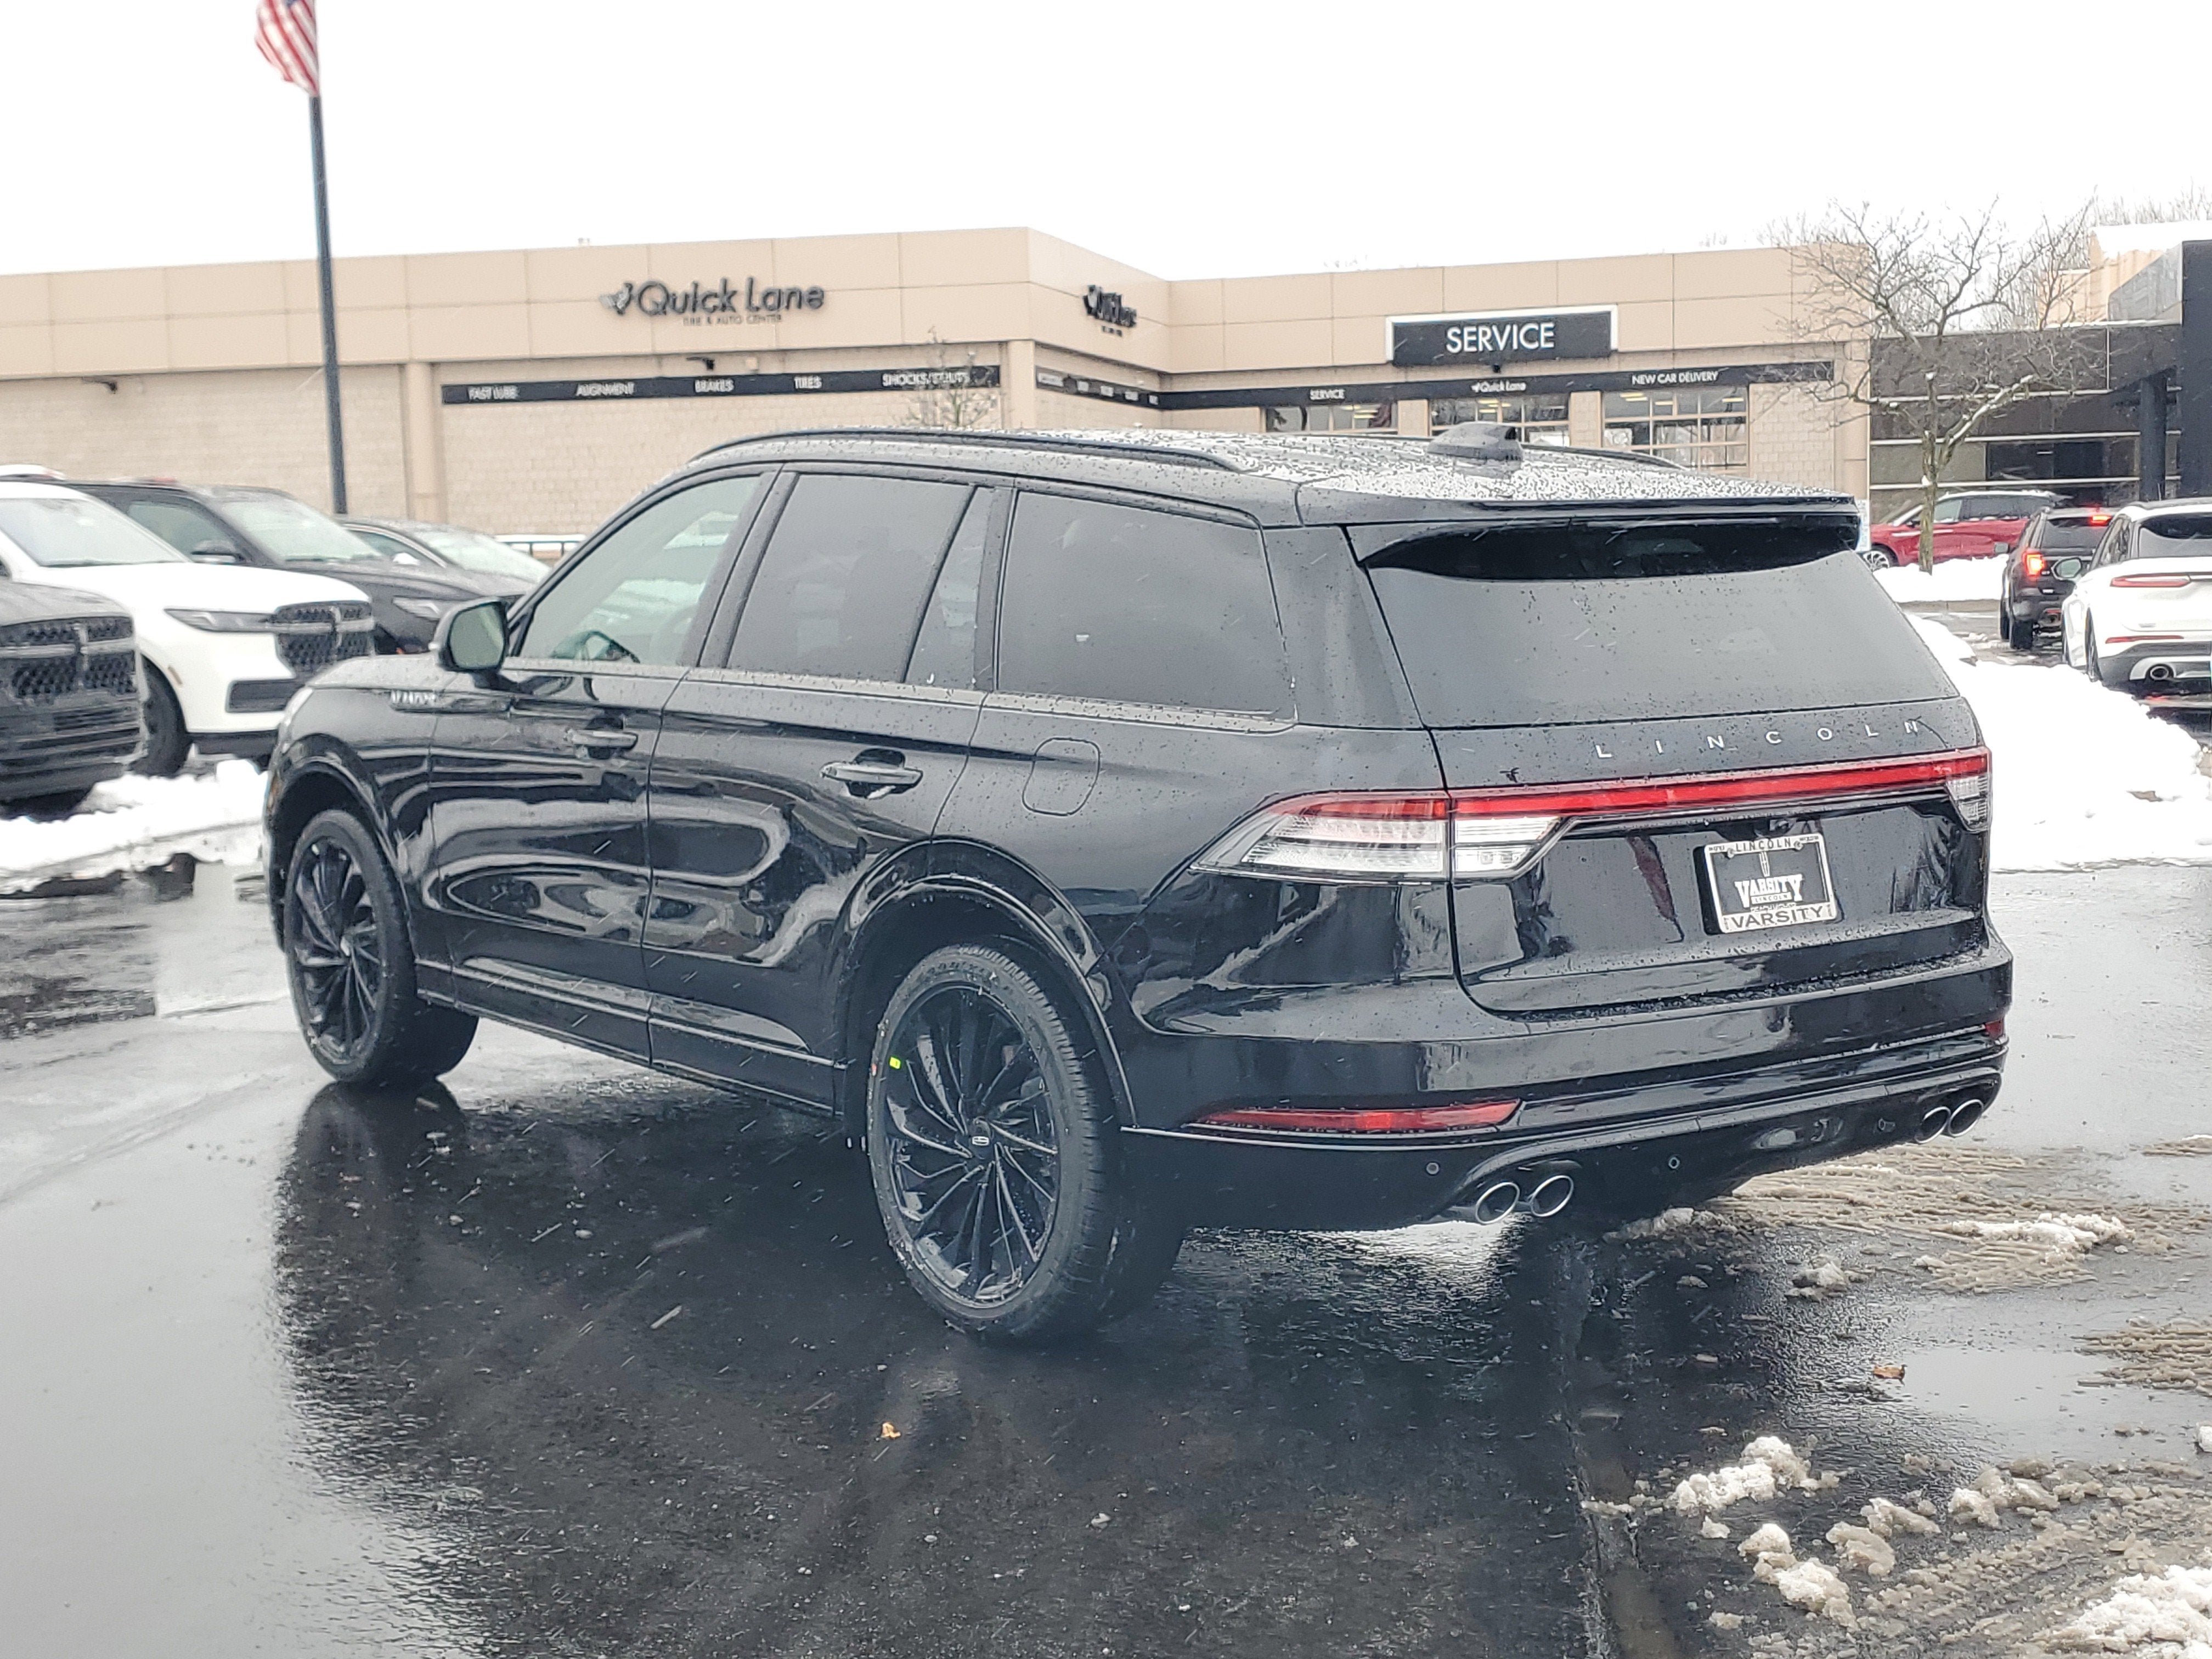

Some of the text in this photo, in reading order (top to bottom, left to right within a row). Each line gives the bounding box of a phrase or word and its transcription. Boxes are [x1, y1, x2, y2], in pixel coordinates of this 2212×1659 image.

[637, 276, 825, 316] Quick Lane
[1445, 321, 1556, 354] SERVICE
[1632, 371, 1719, 385] NEW CAR DELIVERY
[1310, 388, 1346, 400] SERVICE
[1595, 720, 1919, 759] LINCOLN
[1735, 837, 1791, 852] LINCOLN
[1734, 873, 1804, 909] VARSITY
[1754, 894, 1788, 903] LINCOLN
[1731, 905, 1823, 928] VARSITY
